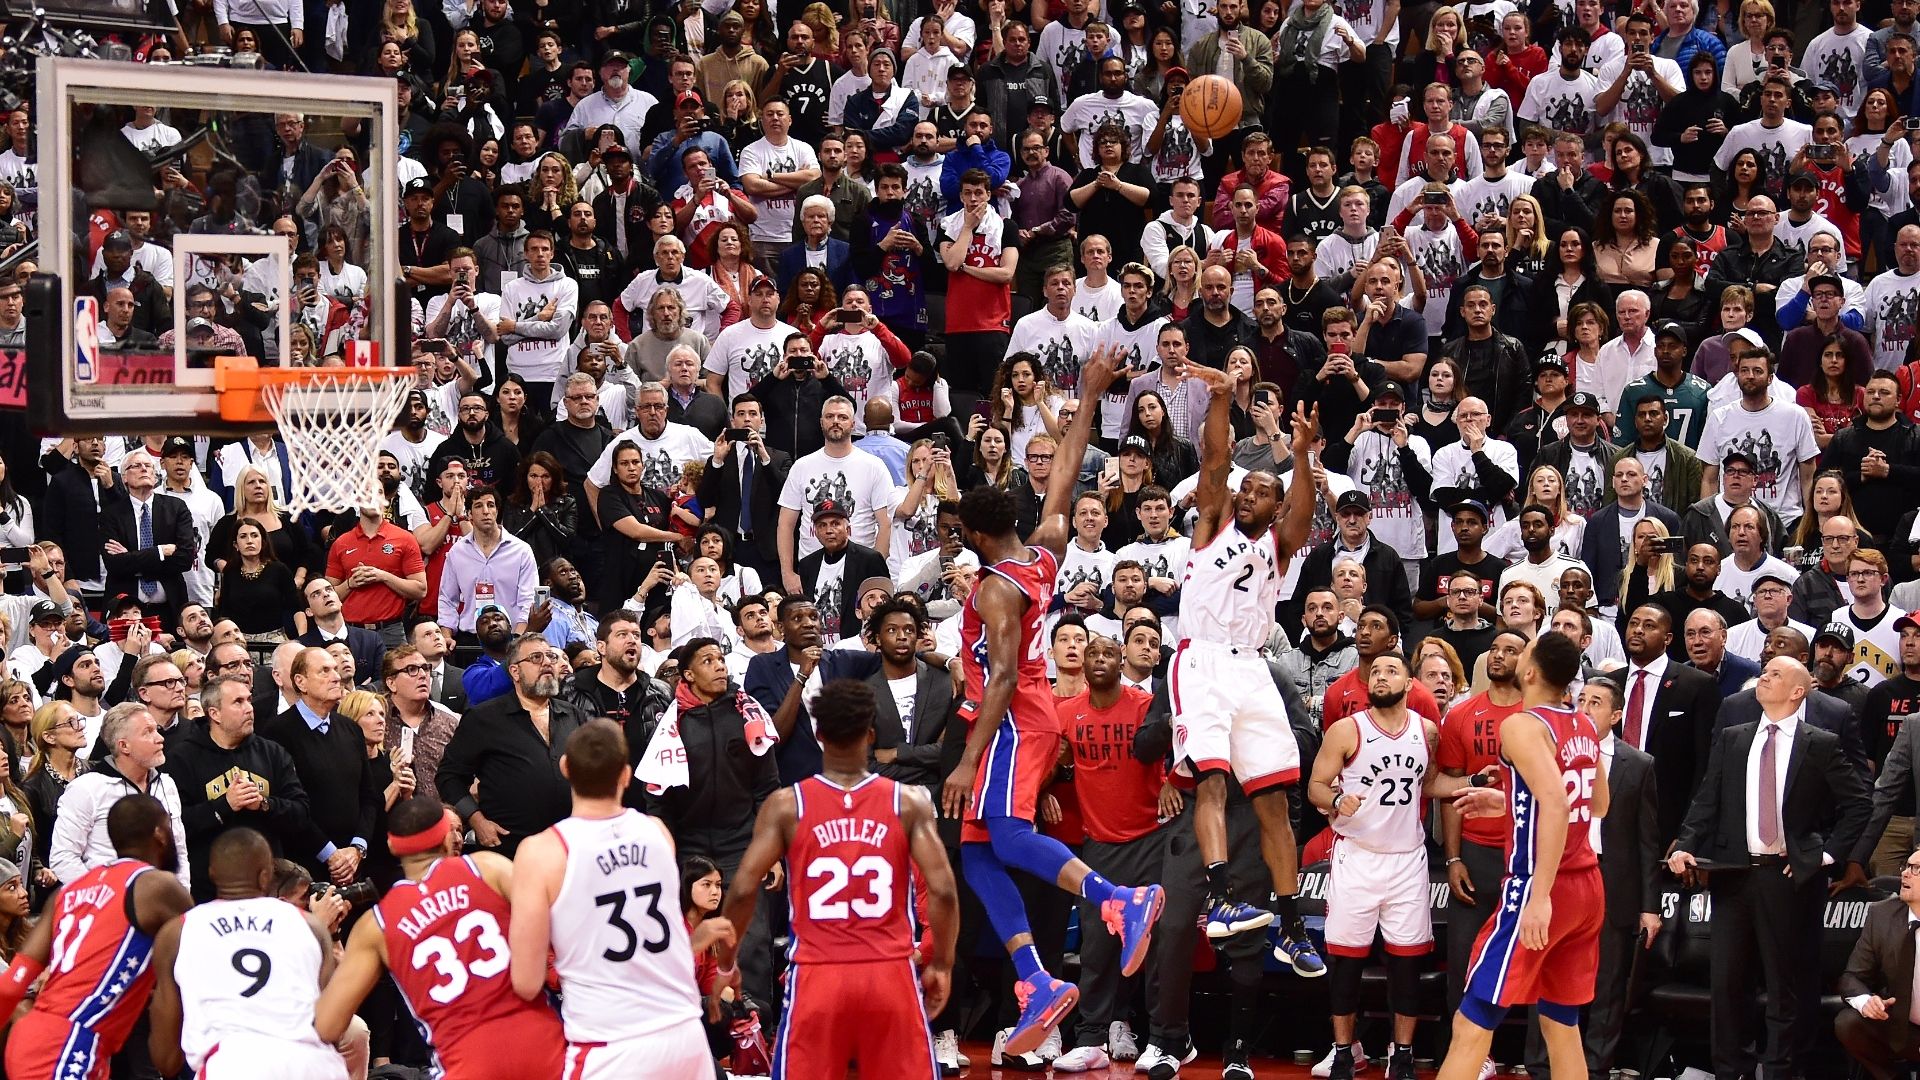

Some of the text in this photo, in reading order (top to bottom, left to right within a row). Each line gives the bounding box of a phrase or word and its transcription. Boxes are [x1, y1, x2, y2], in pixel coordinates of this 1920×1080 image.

[798, 97, 810, 114] 7
[1816, 198, 1830, 218] 2
[518, 340, 558, 353] NORTH
[1233, 563, 1255, 593] 2
[1890, 698, 1910, 713] WE
[1075, 723, 1135, 741] WE THE
[1474, 719, 1495, 737] WE
[1561, 735, 1598, 768] SIMMONS
[1380, 777, 1414, 806] 23
[1562, 767, 1597, 824] 25
[813, 817, 888, 849] BUTLER
[597, 844, 648, 876] GASOL
[807, 855, 894, 921] 23
[210, 915, 273, 937] IBAKA
[397, 884, 471, 941] HARRIS
[595, 882, 671, 962] 33
[50, 913, 95, 975] 11
[411, 909, 512, 1005] 33
[231, 947, 272, 998] 9
